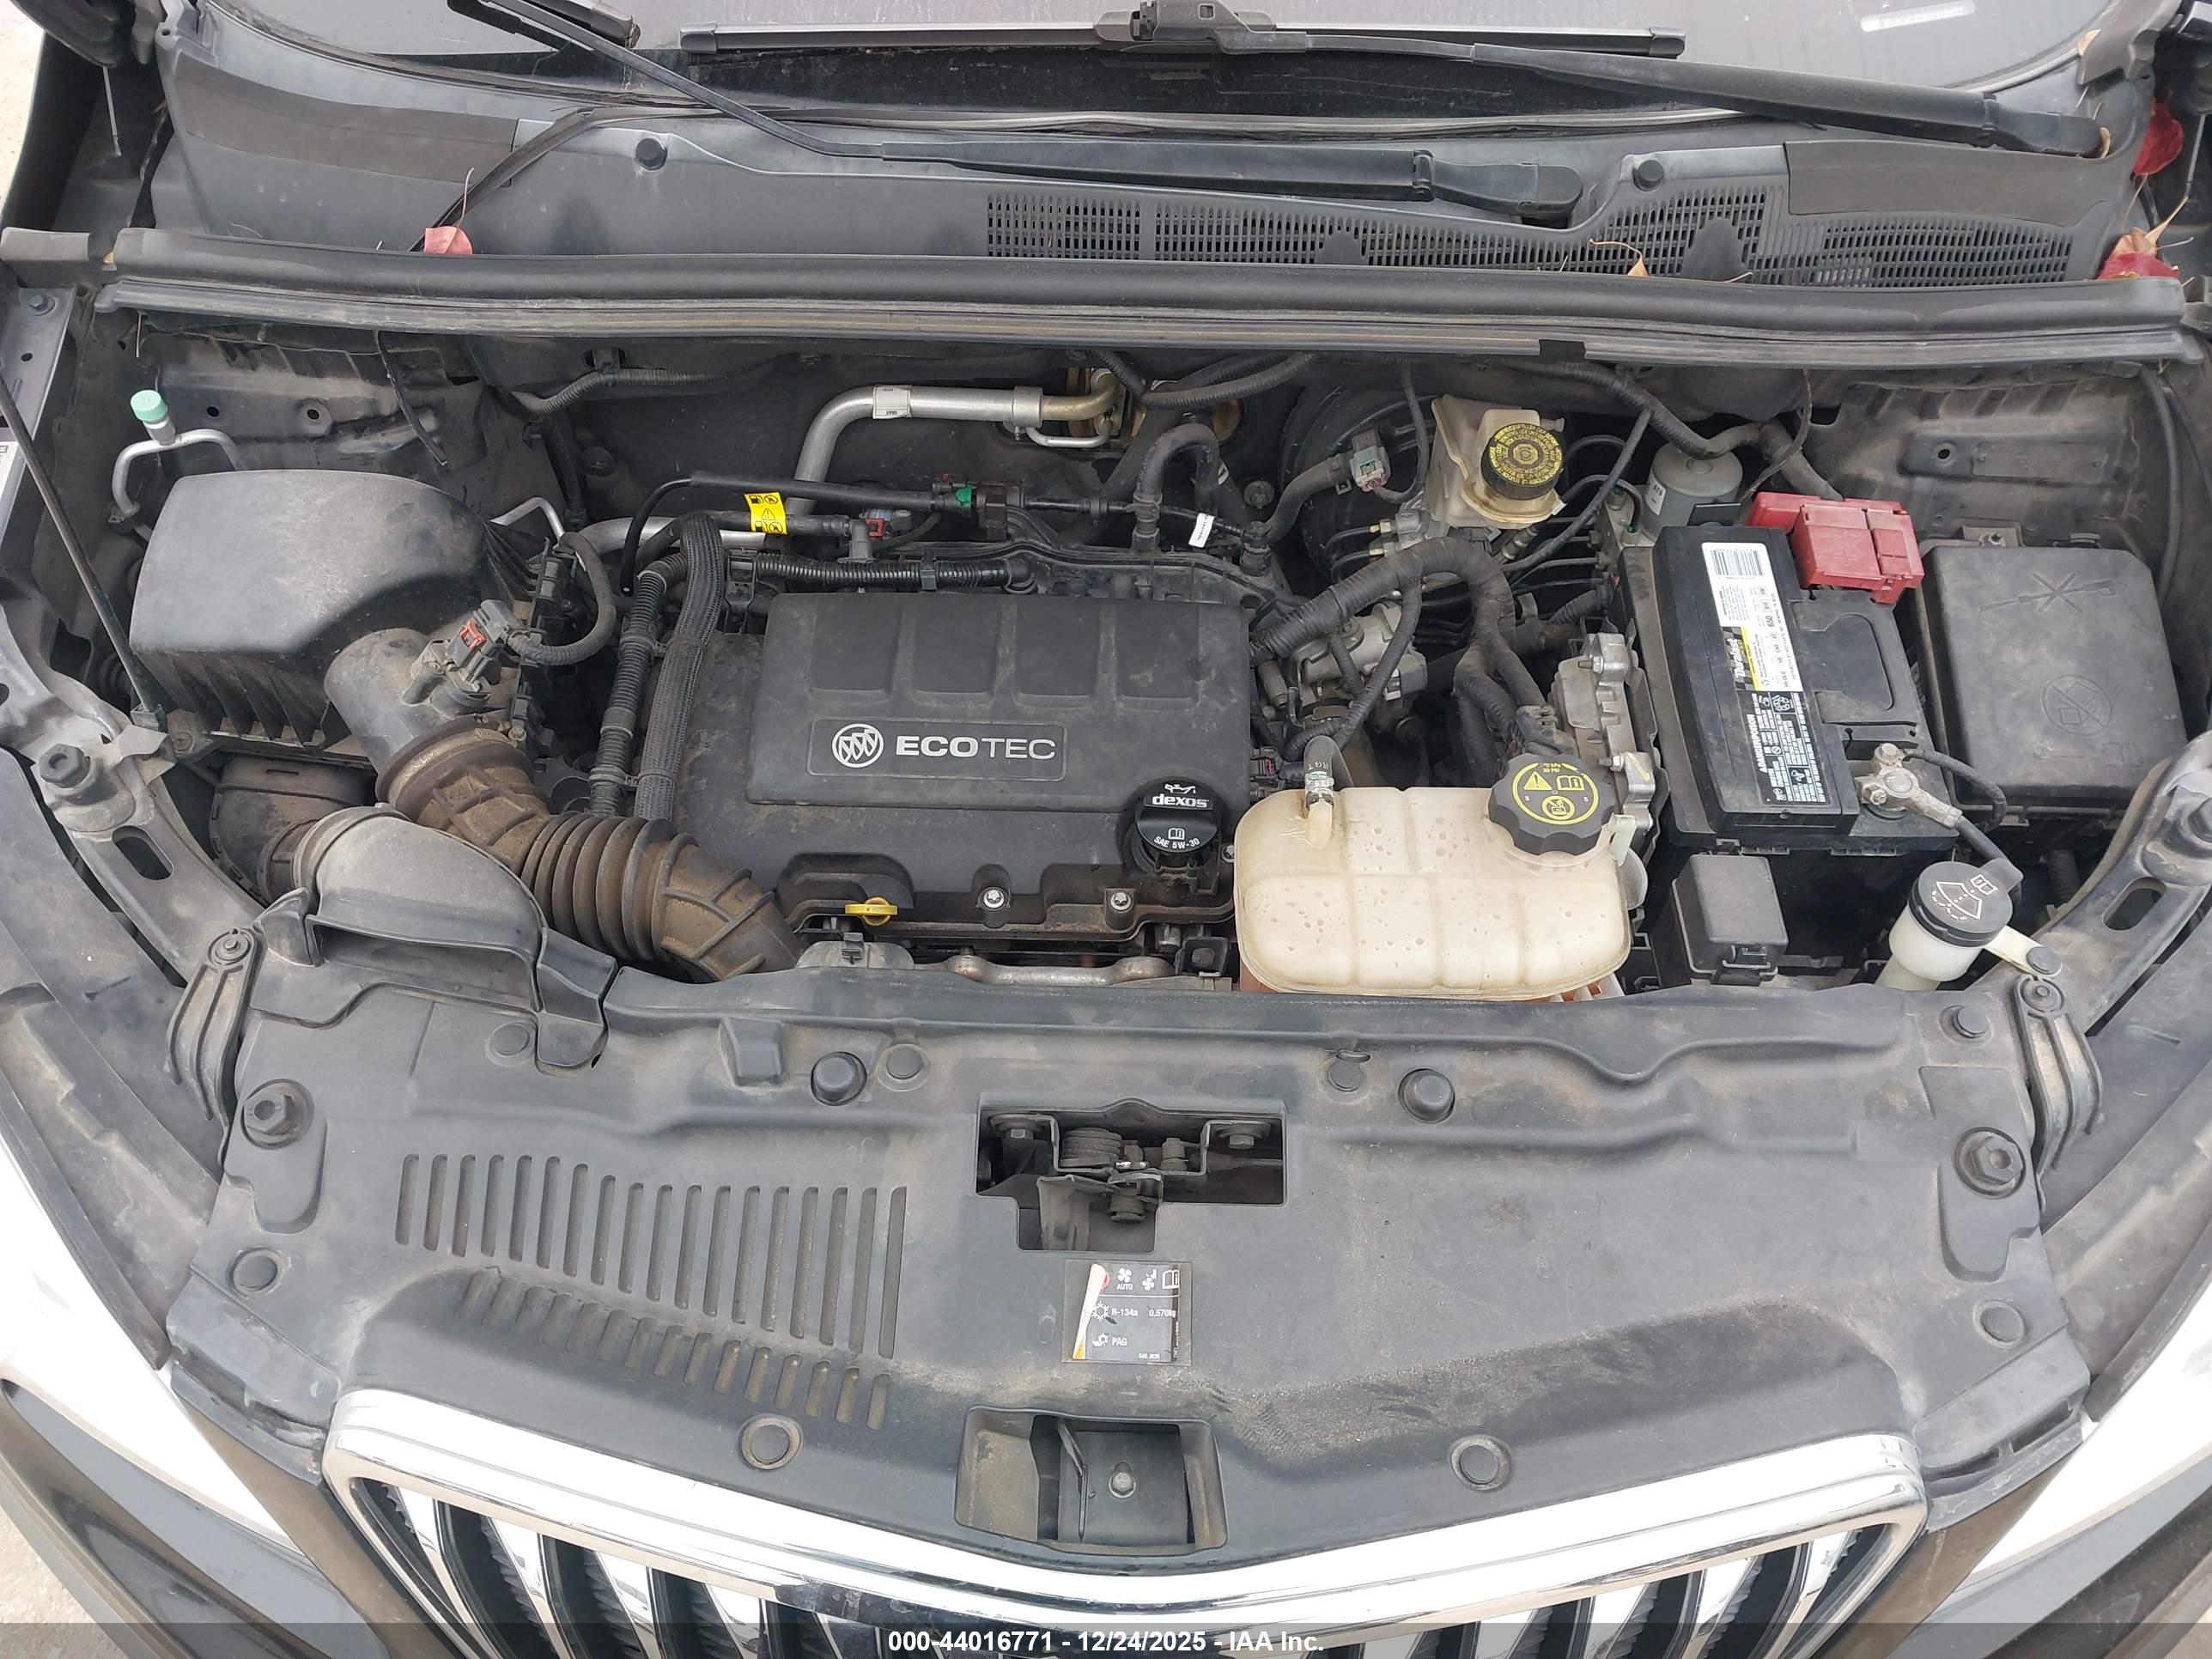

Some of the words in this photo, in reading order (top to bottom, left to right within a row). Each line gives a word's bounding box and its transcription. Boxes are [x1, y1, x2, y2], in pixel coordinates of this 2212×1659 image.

[1765, 615, 1774, 627] 650
[1726, 638, 1747, 678] Duralast
[896, 735, 1056, 760] ECOTEC
[1152, 793, 1209, 808] dexos
[1153, 836, 1169, 848] SAE
[1172, 837, 1200, 849] 5W-30
[1111, 1308, 1139, 1317] R-134a
[1112, 1337, 1127, 1346] PAG
